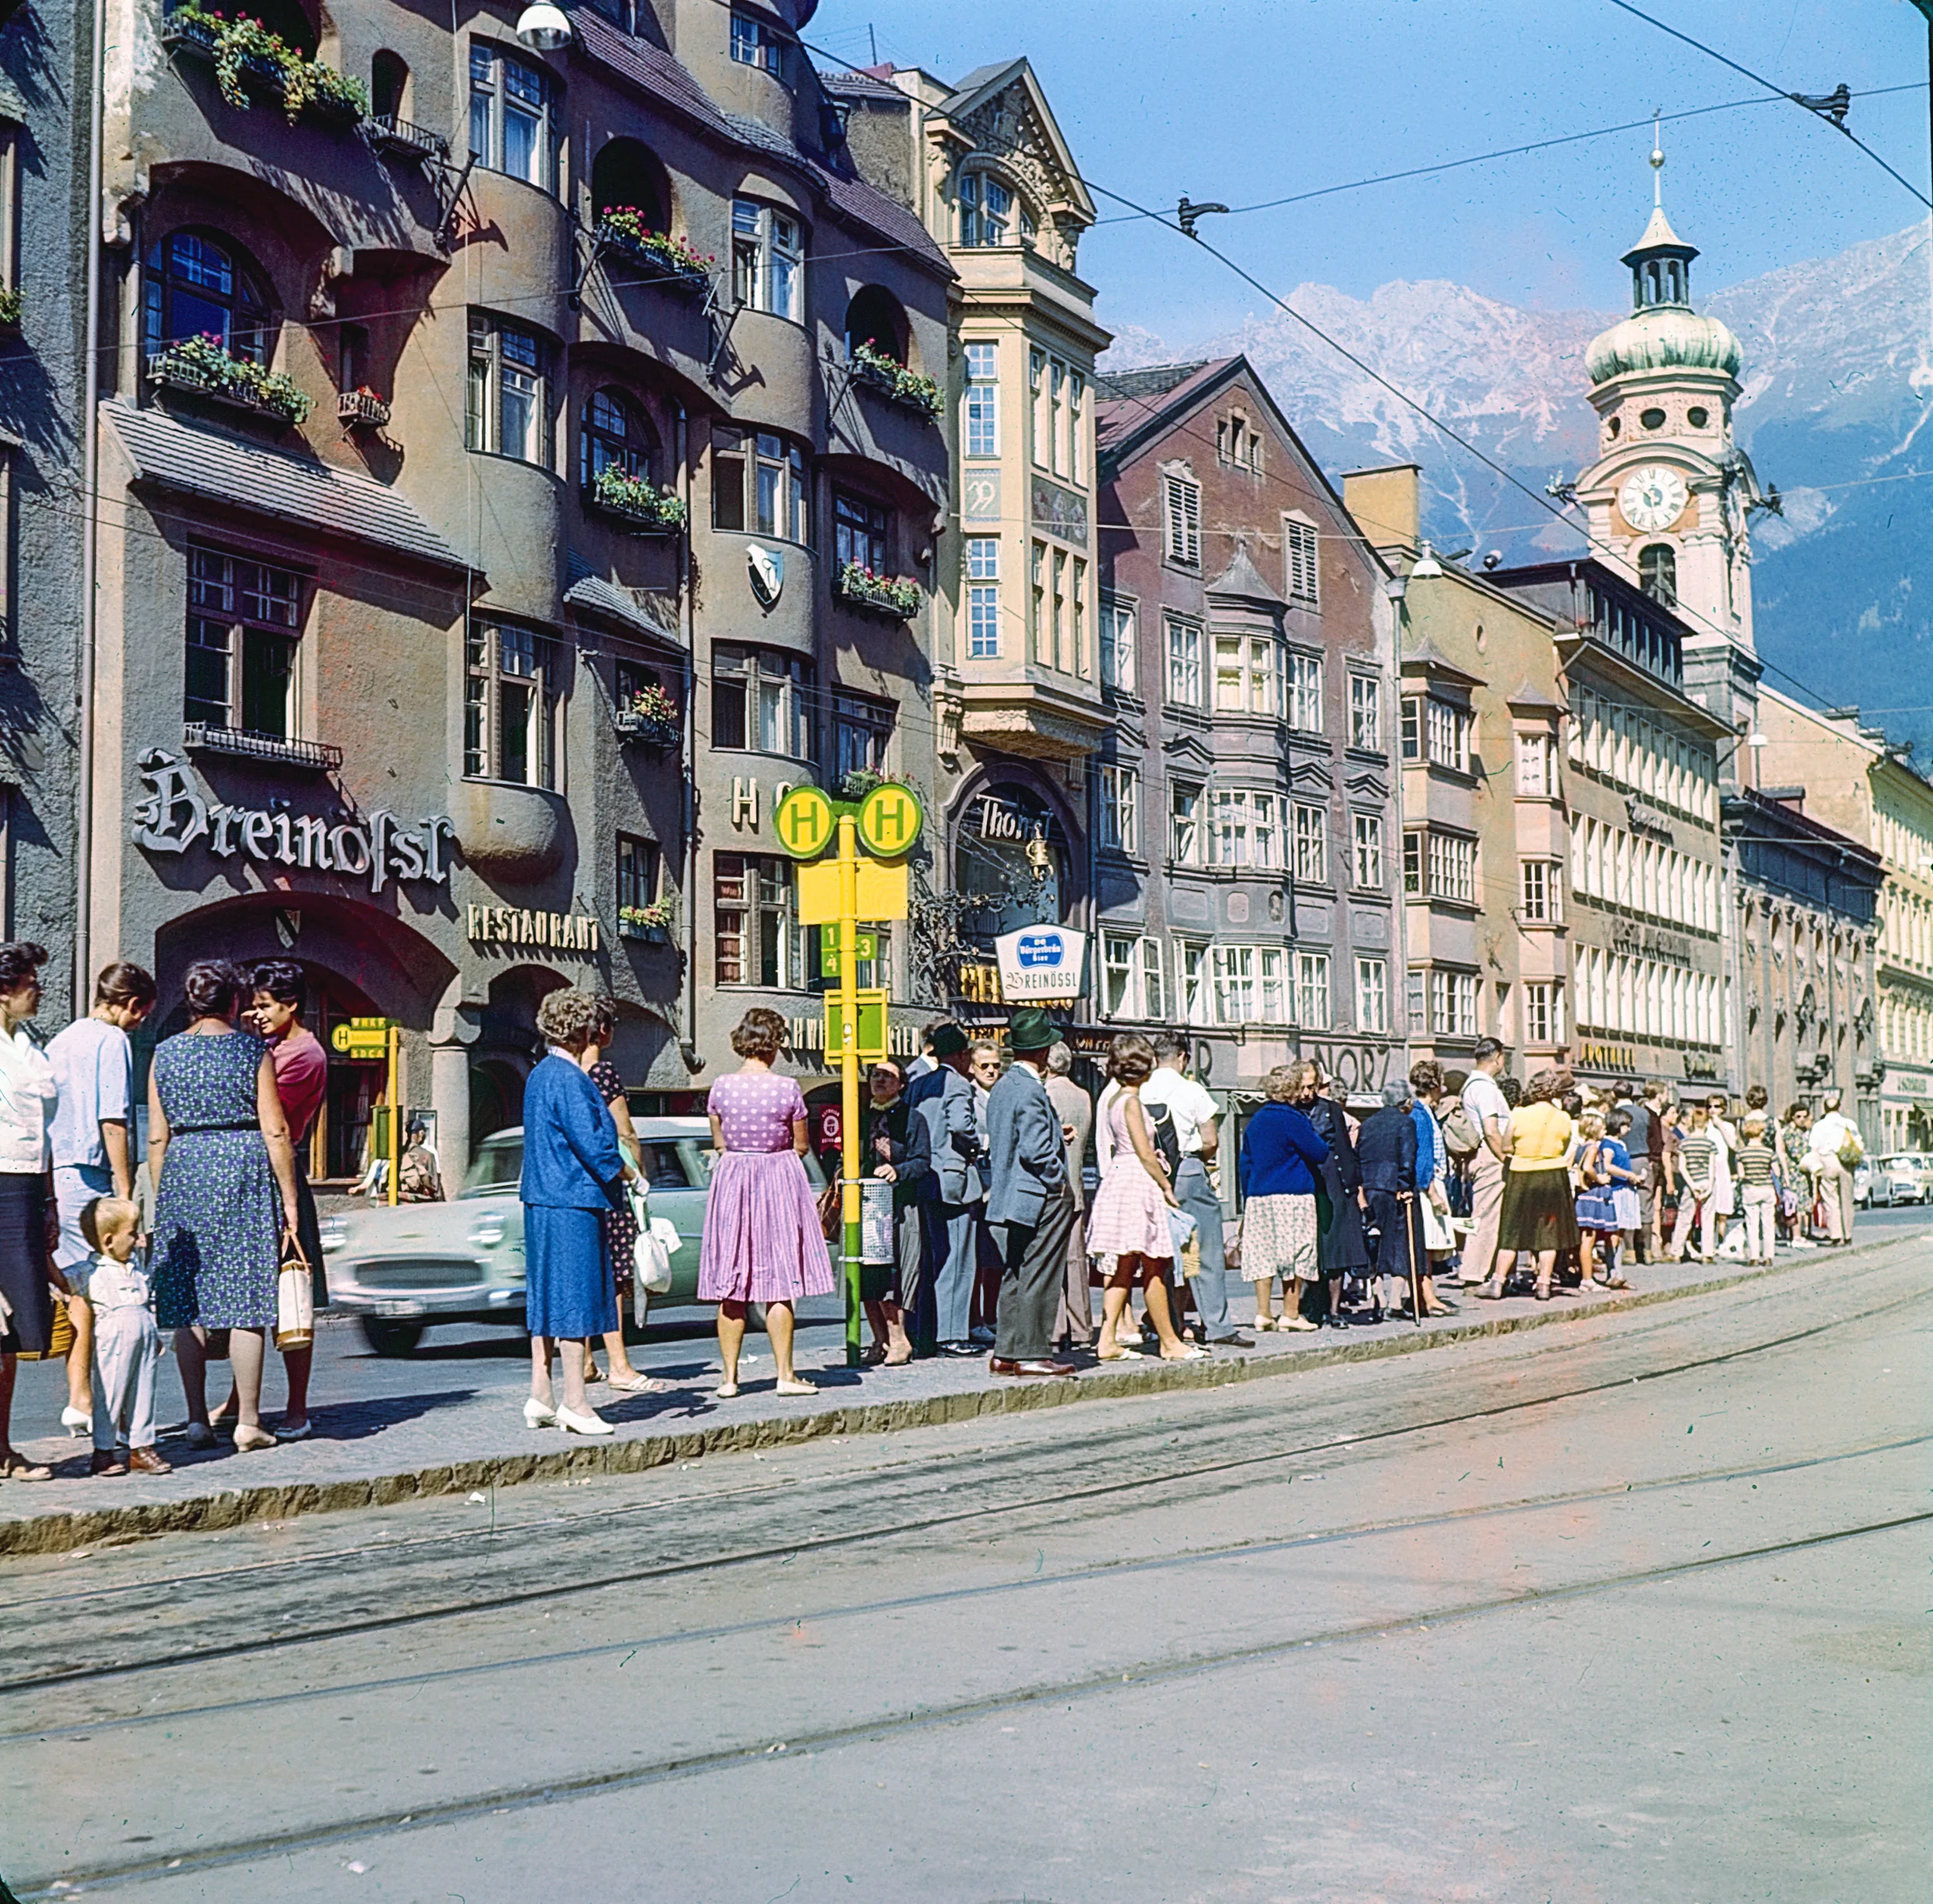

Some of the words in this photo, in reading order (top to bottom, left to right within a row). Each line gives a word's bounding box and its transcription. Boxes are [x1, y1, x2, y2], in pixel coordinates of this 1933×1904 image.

[790, 801, 818, 844] H
[875, 798, 905, 842] H
[467, 904, 599, 951] RESTAURANT
[827, 927, 834, 946] 1
[860, 938, 871, 957] 3
[826, 954, 838, 972] 4
[338, 1030, 349, 1045] H
